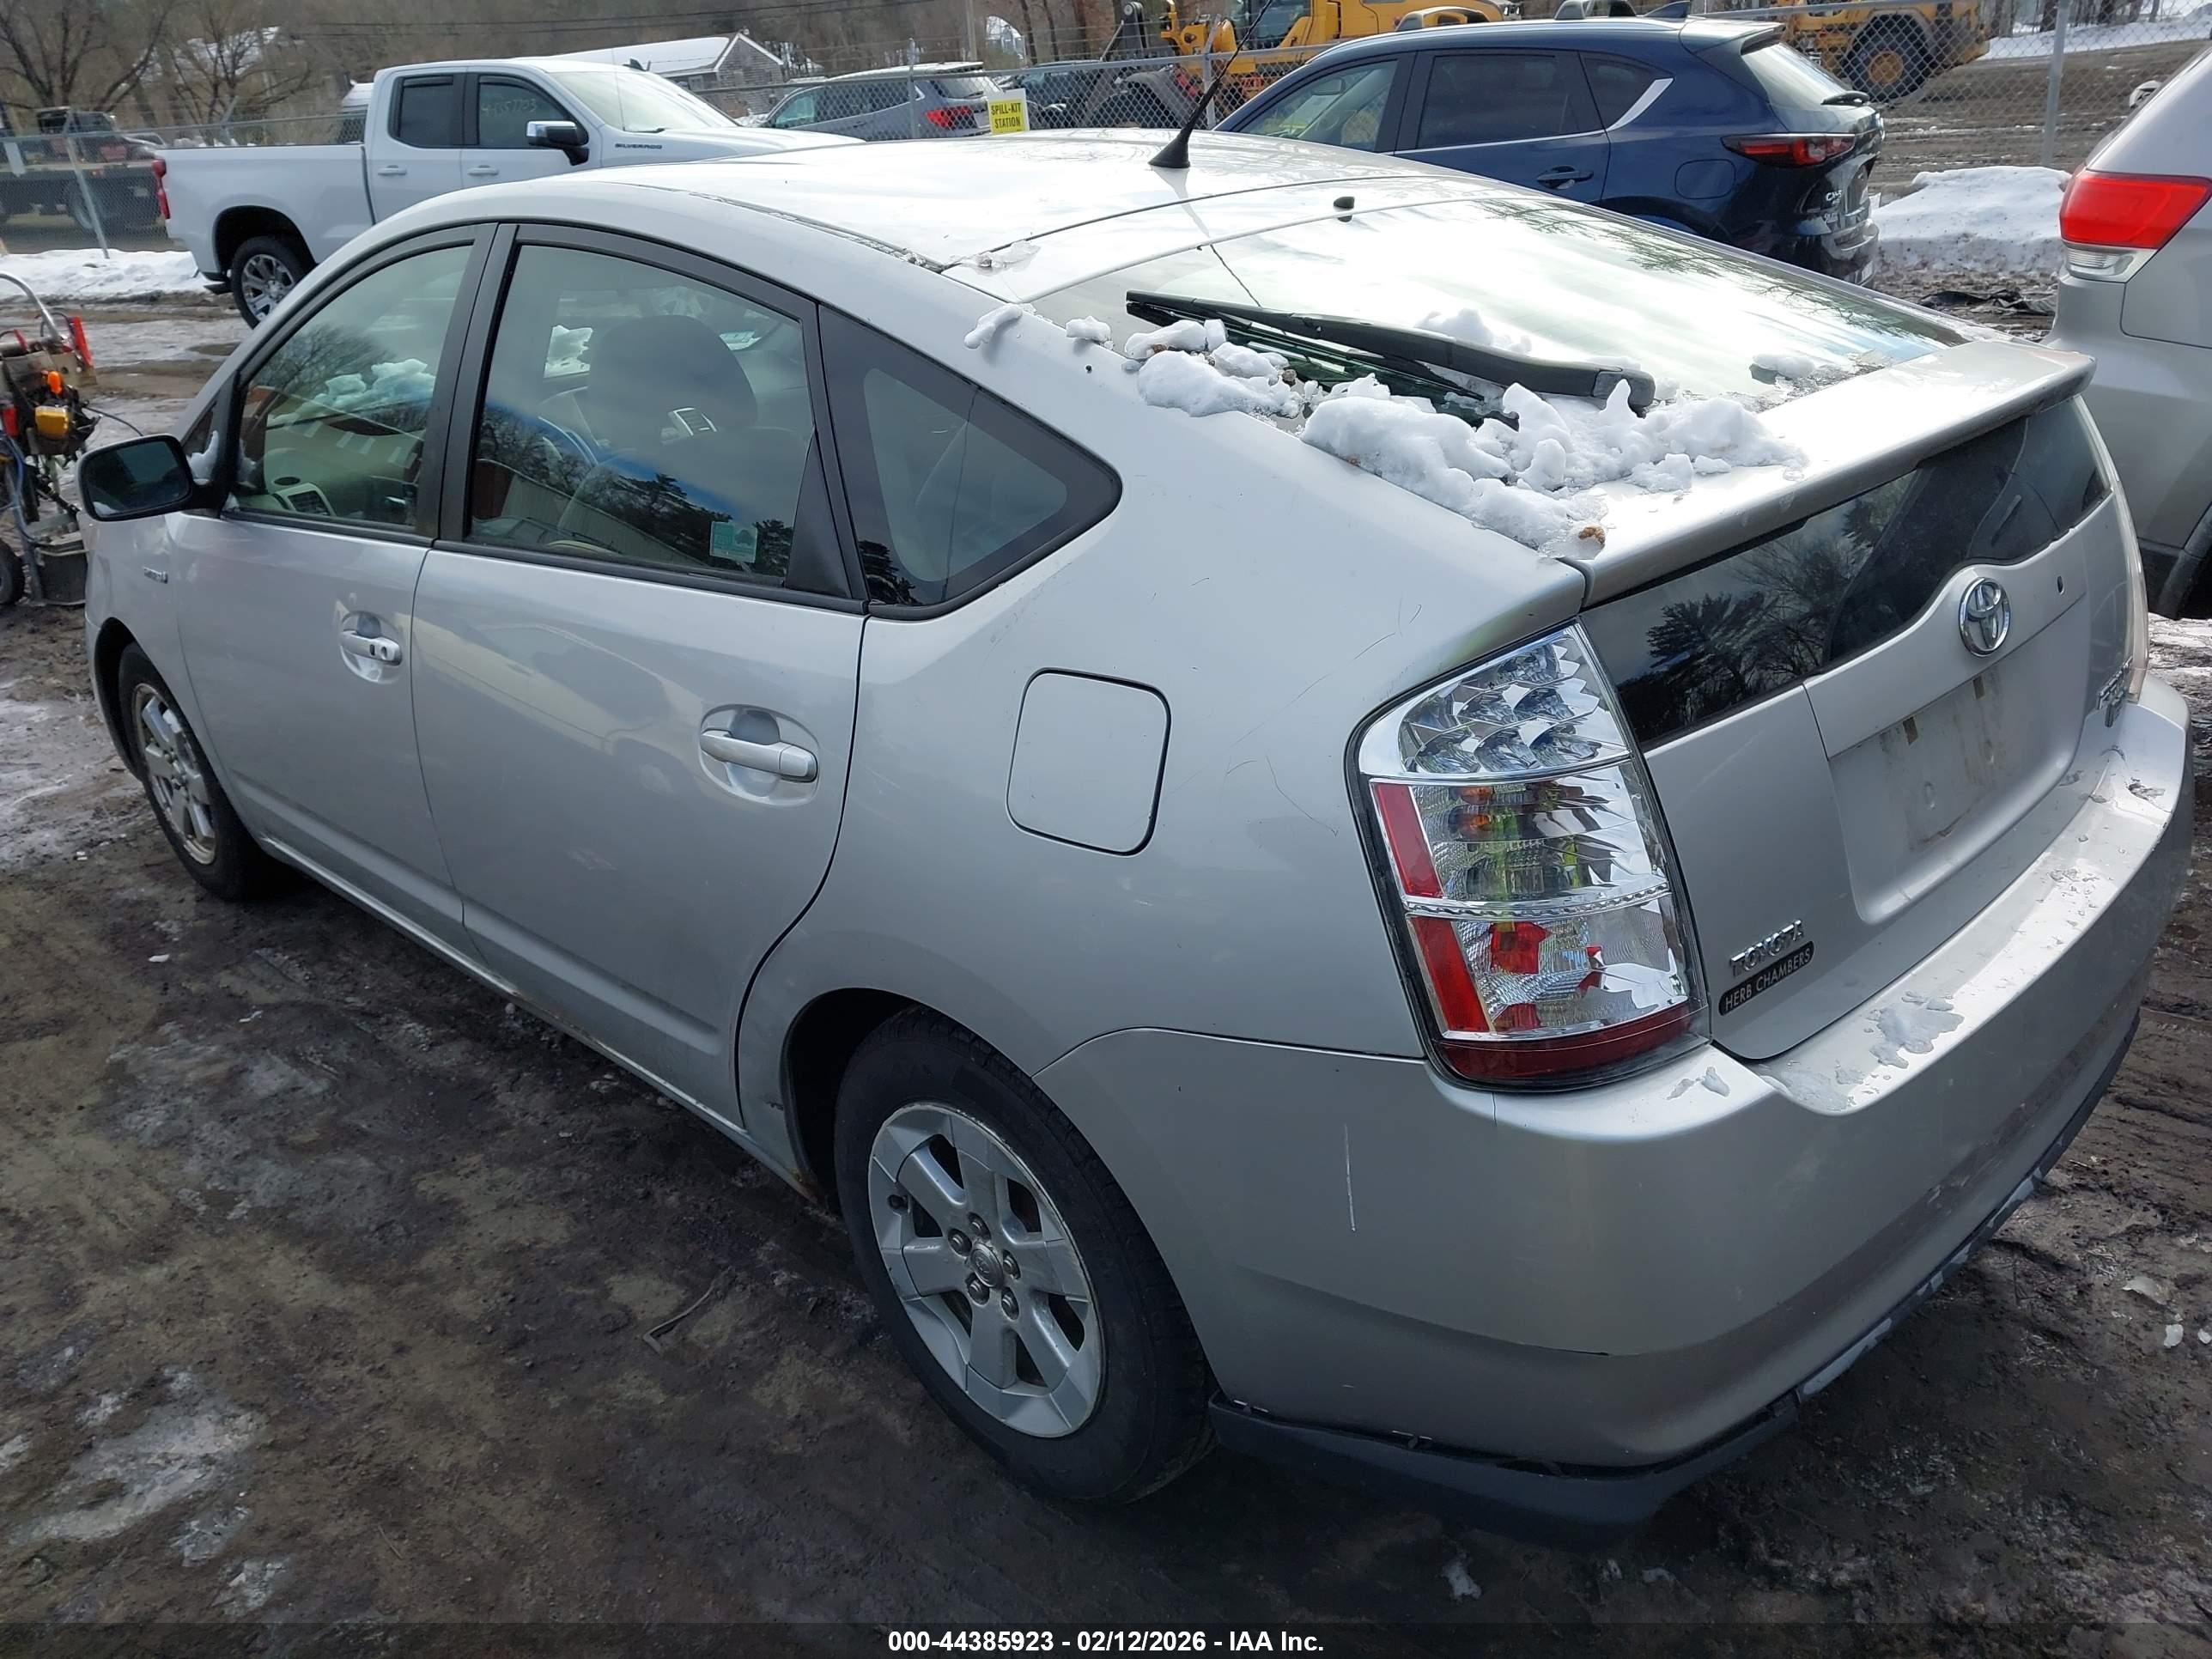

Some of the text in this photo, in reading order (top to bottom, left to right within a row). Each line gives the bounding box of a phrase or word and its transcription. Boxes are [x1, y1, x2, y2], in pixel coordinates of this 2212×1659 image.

[990, 102, 1022, 116] SPILL-KIT
[994, 116, 1021, 129] STATION
[1729, 919, 1803, 977] TOYOTA
[1724, 947, 1811, 1011] HERB CHAMBERS
